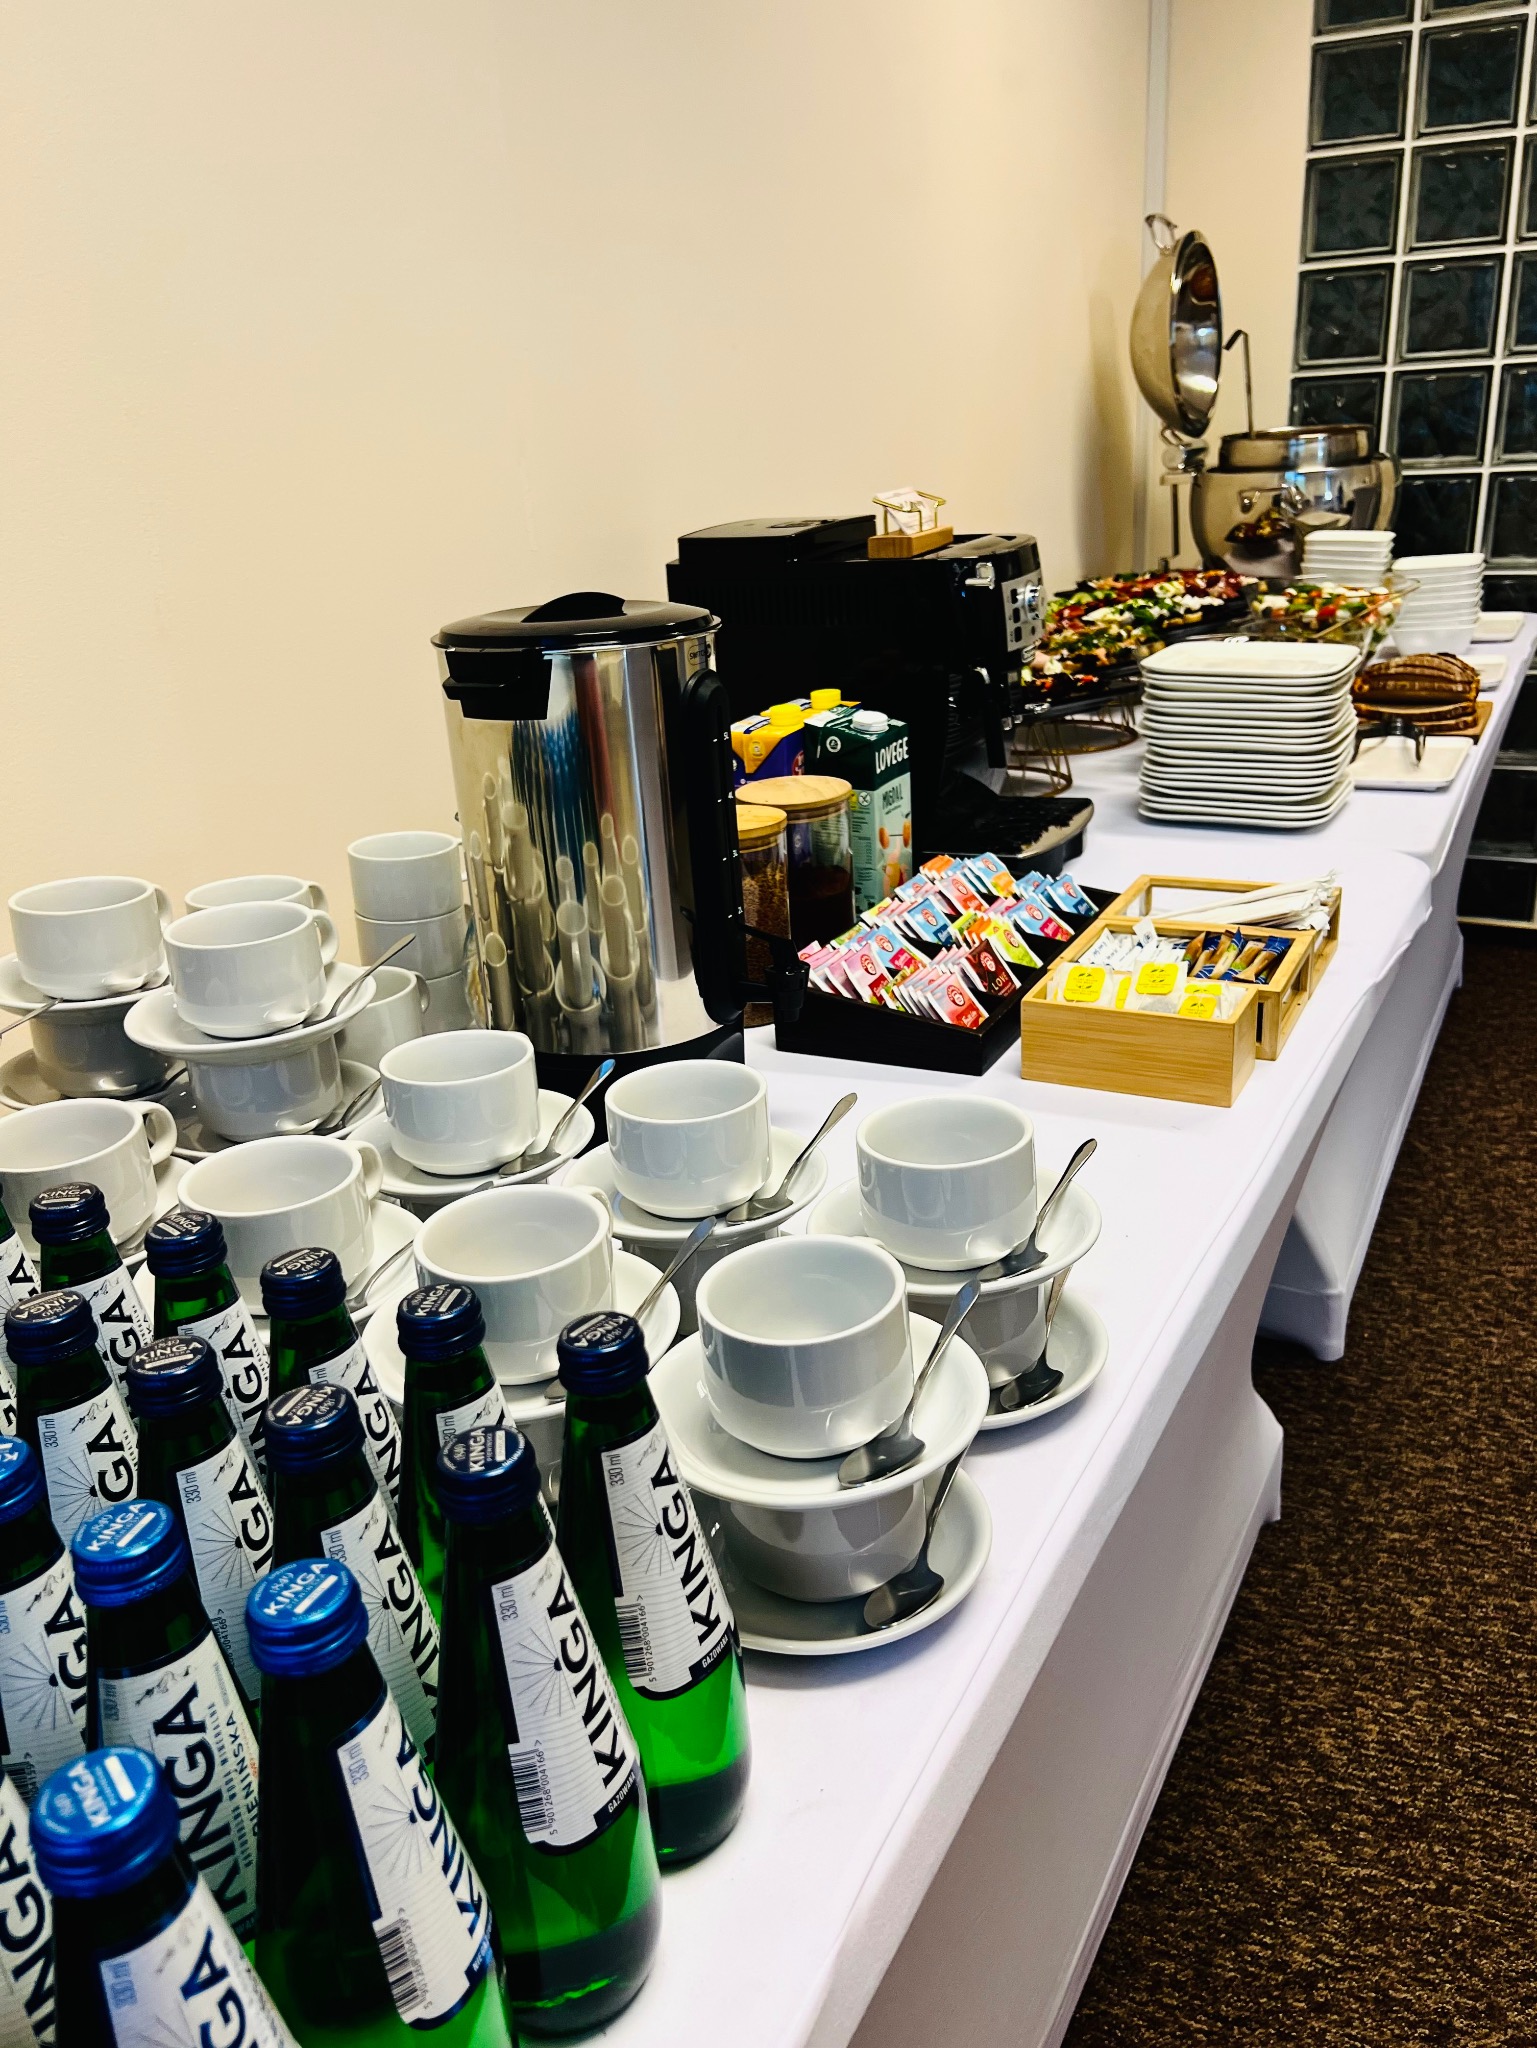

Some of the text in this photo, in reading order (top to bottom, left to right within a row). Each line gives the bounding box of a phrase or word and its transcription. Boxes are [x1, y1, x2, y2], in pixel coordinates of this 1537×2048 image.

[875, 737, 909, 774] LOVEGE
[39, 1188, 92, 1199] KINGA
[168, 1213, 202, 1233] KINGA
[275, 1250, 329, 1275] KINGA
[15, 1294, 80, 1319] KINGA
[414, 1283, 450, 1316] KINGA
[573, 1315, 629, 1348] KINGA
[135, 1341, 203, 1363] KINGA
[285, 1385, 337, 1426] KINGA
[440, 1415, 454, 1427] ml
[41, 1418, 59, 1448] 330 ml
[469, 1427, 486, 1473] KINGA
[182, 1471, 202, 1504] 330 ml
[607, 1453, 625, 1487] 330 ml
[86, 1502, 148, 1552] KINGA
[328, 1529, 342, 1541] ml
[651, 1444, 721, 1646] KINGA
[262, 1563, 330, 1616] KINGA
[499, 1584, 519, 1622] 330 ml
[638, 1605, 650, 1640] 004166
[642, 1640, 655, 1676] 901268
[702, 1633, 729, 1669] GAZOWANA
[547, 1573, 626, 1789] KINGA
[345, 1741, 370, 1786] 330 ml
[536, 1748, 550, 1788] 004166
[543, 1788, 556, 1828] 901268
[607, 1771, 637, 1814] GAZOWANA
[397, 1716, 483, 1939] KINGA
